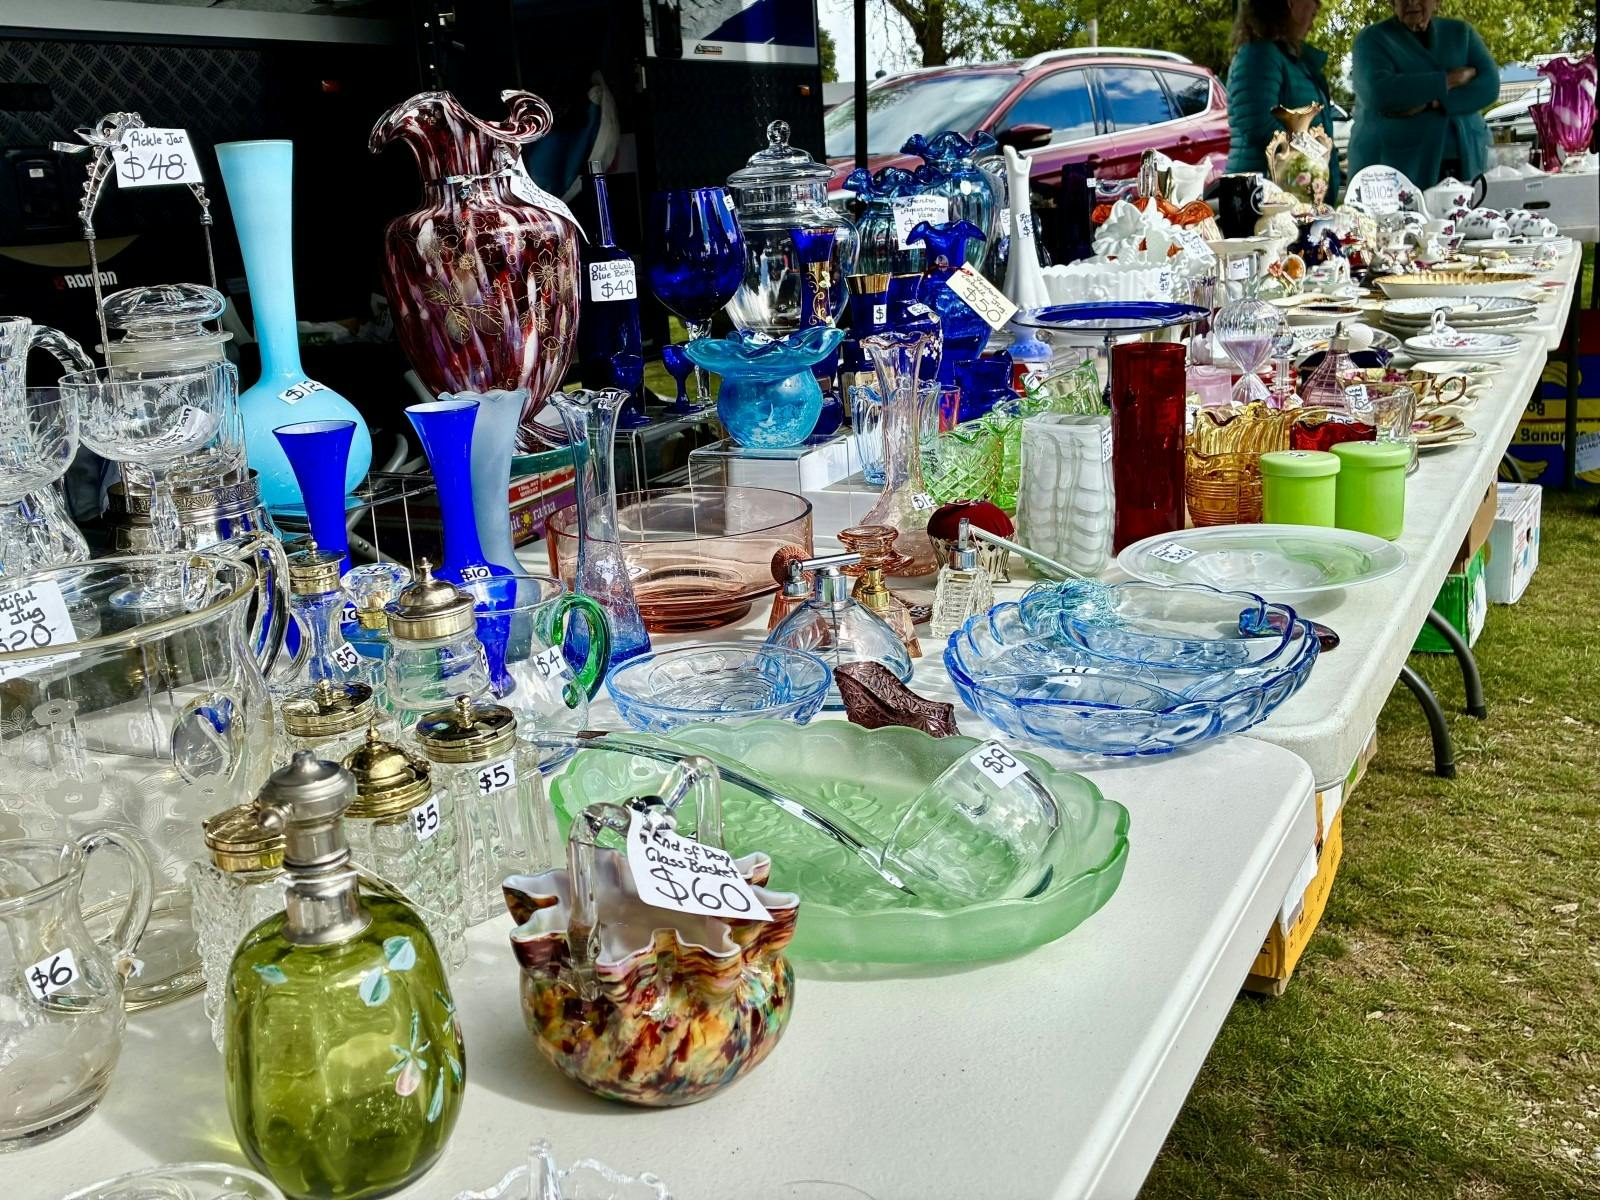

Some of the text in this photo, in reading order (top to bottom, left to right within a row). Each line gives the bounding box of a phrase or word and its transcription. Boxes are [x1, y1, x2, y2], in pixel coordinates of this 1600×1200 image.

[128, 130, 185, 148] Pickle Jar
[591, 261, 632, 272] Old Cobalt
[591, 271, 611, 281] Blue
[600, 279, 634, 299] $40
[962, 287, 1001, 323] $50
[461, 567, 489, 582] $10
[9, 607, 46, 626] Jug
[335, 646, 358, 671] $5
[536, 649, 560, 677] $4
[979, 747, 1017, 774] $8
[479, 764, 510, 794] $5
[416, 803, 438, 834] $5
[652, 831, 731, 867] End of Day
[645, 846, 739, 880] Glass Basket
[649, 864, 751, 913] $60
[30, 955, 73, 995] $6
